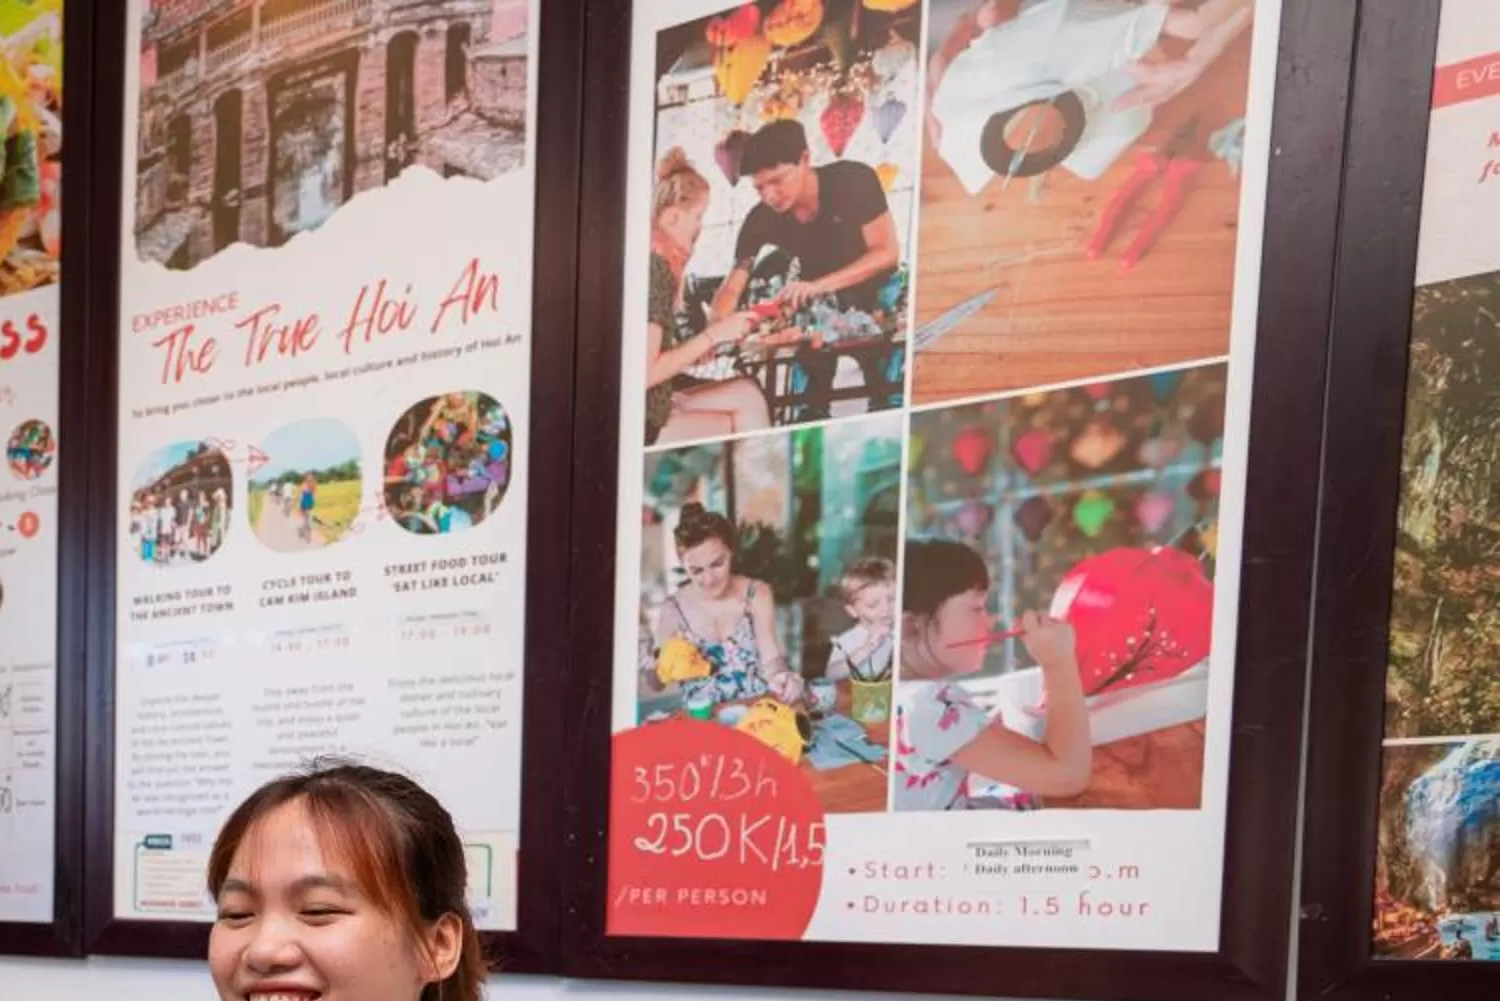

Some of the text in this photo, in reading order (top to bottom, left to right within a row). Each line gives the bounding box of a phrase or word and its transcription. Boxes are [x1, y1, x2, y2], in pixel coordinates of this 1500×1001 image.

[132, 292, 240, 333] EXPERIENCE
[153, 257, 501, 384] The True Hoi An
[352, 359, 393, 377] culture
[395, 352, 419, 367] and
[420, 344, 463, 362] history
[465, 338, 479, 353] of
[504, 332, 523, 344] An
[383, 551, 508, 576] STREET FOOD TOUR
[261, 569, 352, 591] CYCLE TOUR TO
[420, 576, 449, 591] LIKE
[132, 583, 233, 606] WALKING TOUR TO
[259, 586, 357, 609] CAM KIM ISLAND
[151, 604, 197, 620] ANCIENT
[199, 600, 235, 614] TOWN
[975, 845, 1073, 858] Daily Morning
[864, 860, 947, 880] Start:
[974, 863, 1080, 875] Daily afternoon
[677, 887, 768, 905] PERSON
[863, 895, 1003, 915] Duration:
[1019, 896, 1060, 915] 1.5
